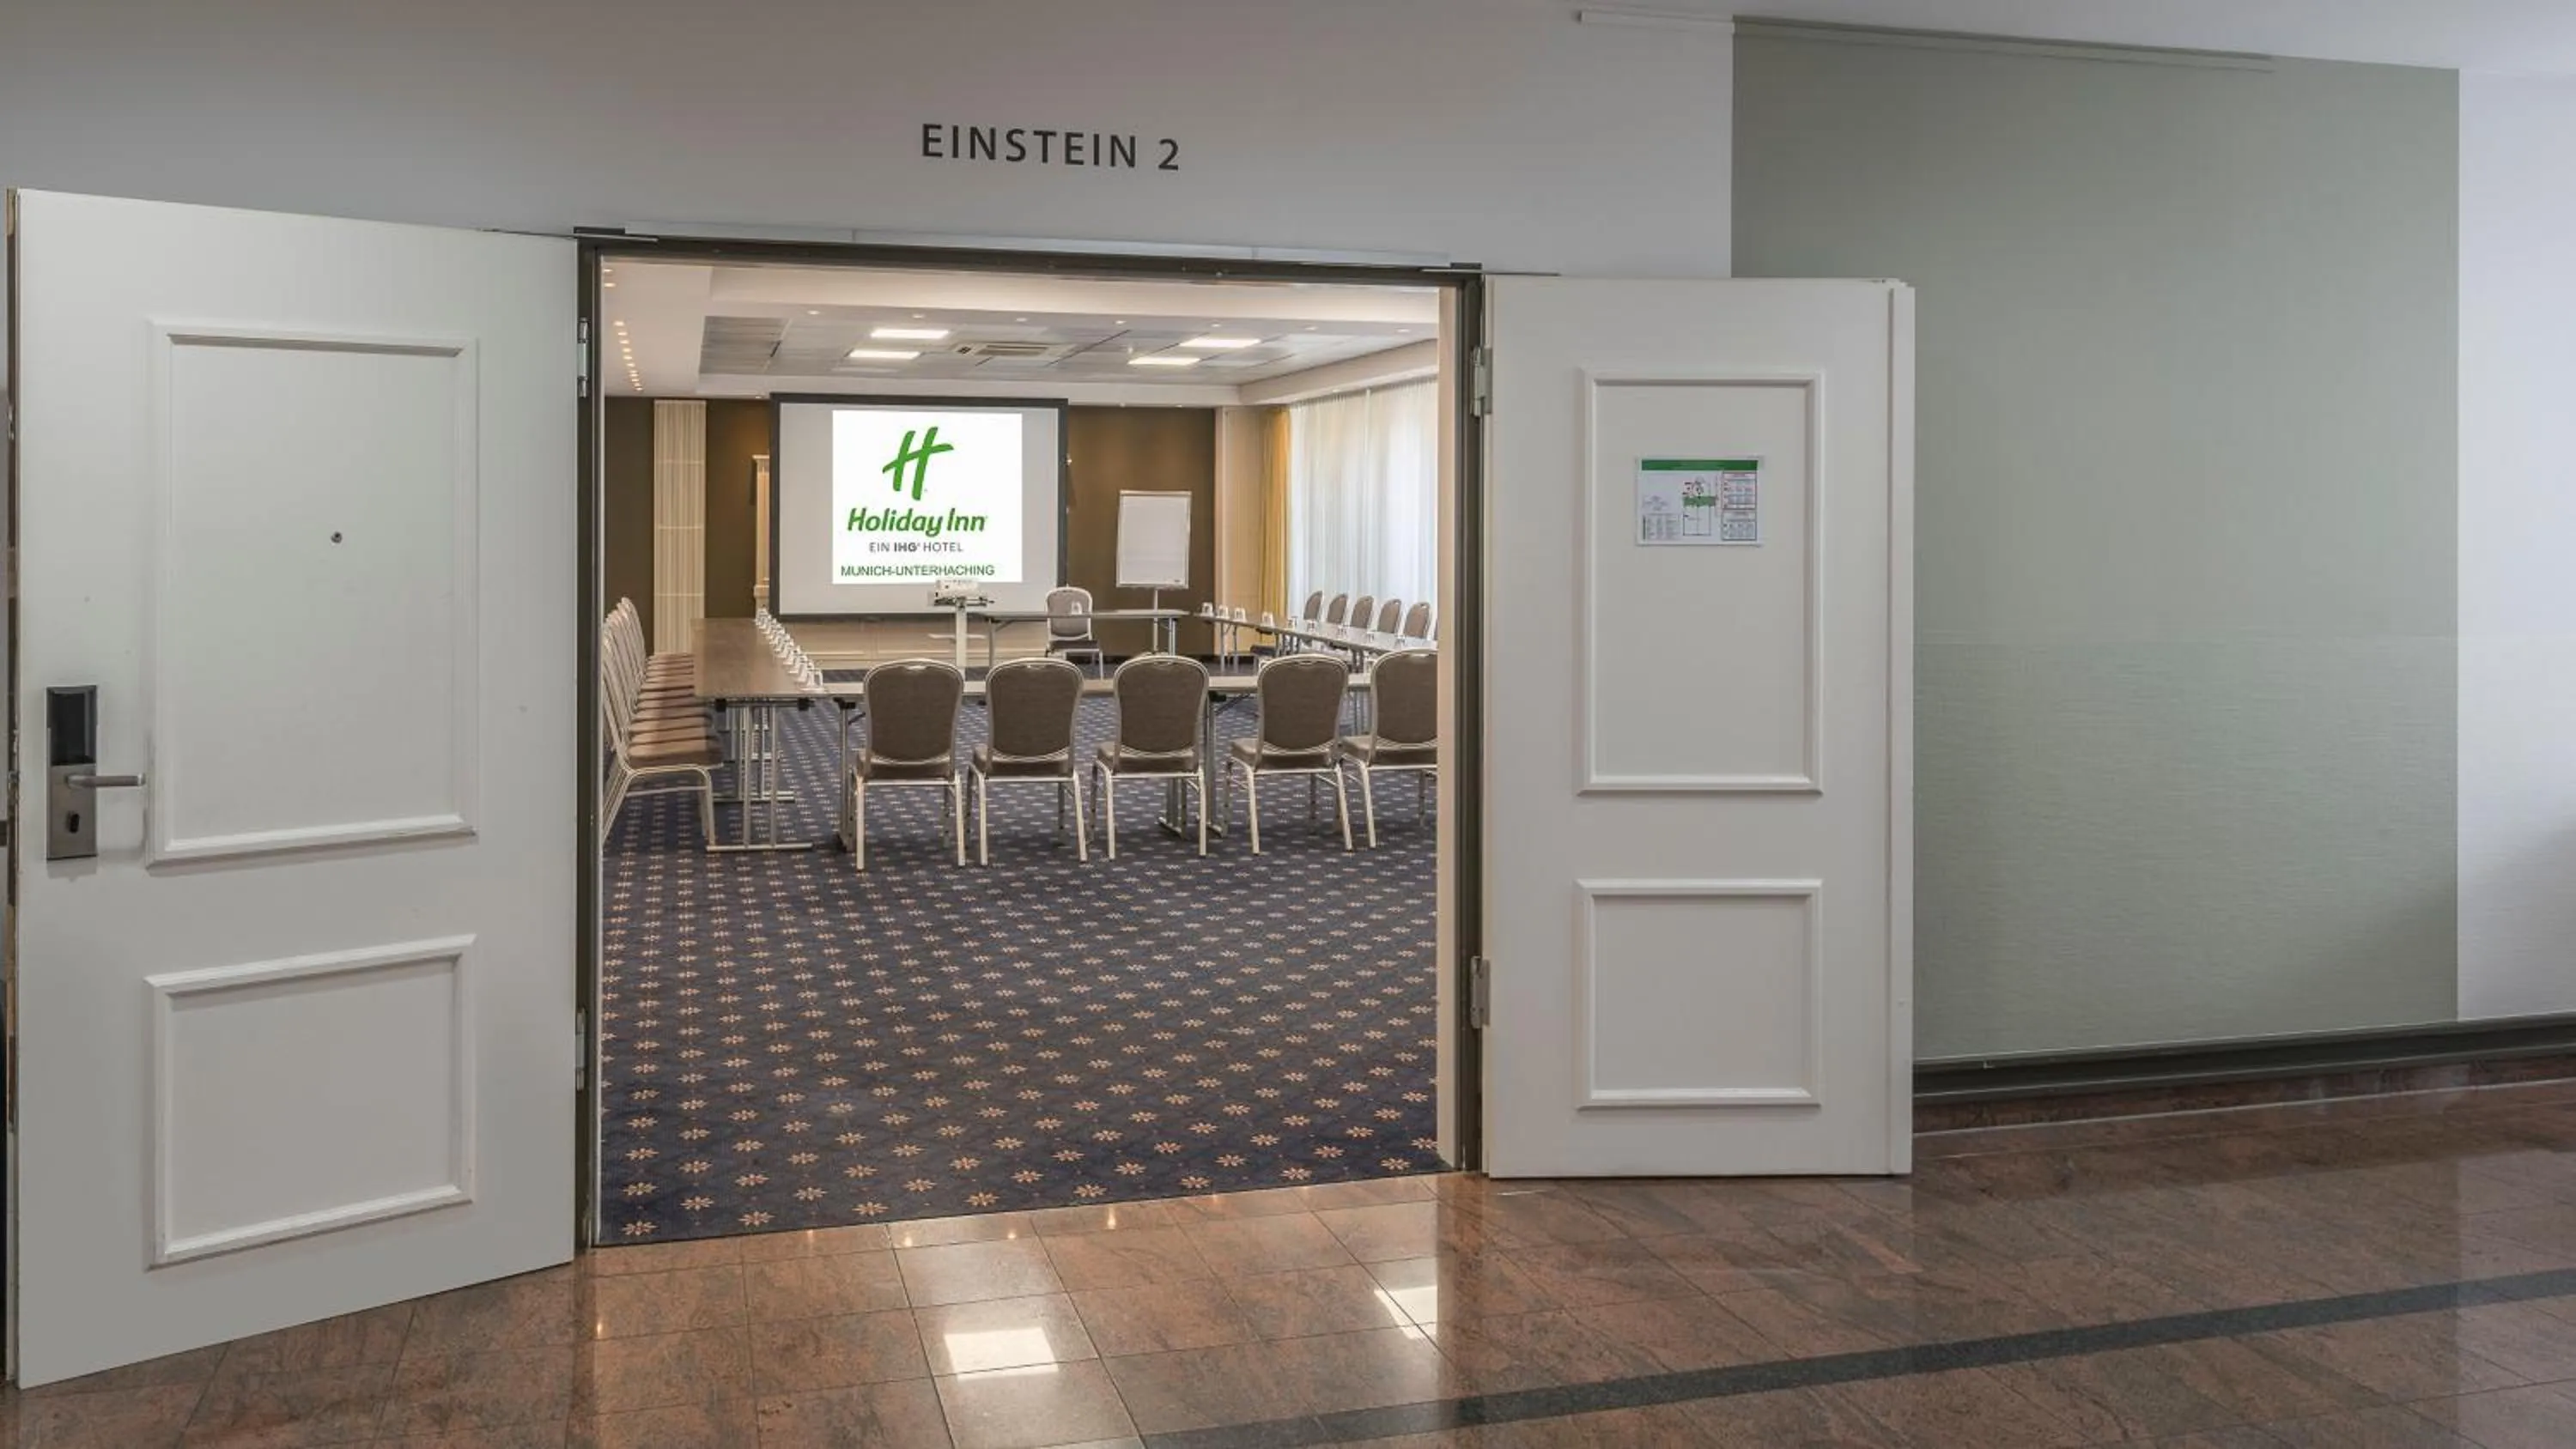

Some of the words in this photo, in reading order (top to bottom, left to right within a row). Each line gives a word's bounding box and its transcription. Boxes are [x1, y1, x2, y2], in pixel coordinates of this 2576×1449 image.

[922, 124, 1136, 168] EINSTEIN
[1158, 138, 1180, 171] 2
[882, 426, 954, 500] H
[847, 507, 943, 538] Holiday
[947, 507, 987, 531] Inn
[869, 542, 890, 553] EIN
[923, 542, 963, 553] HOTEL
[841, 565, 995, 577] MUNICH-UNTERHACHING
